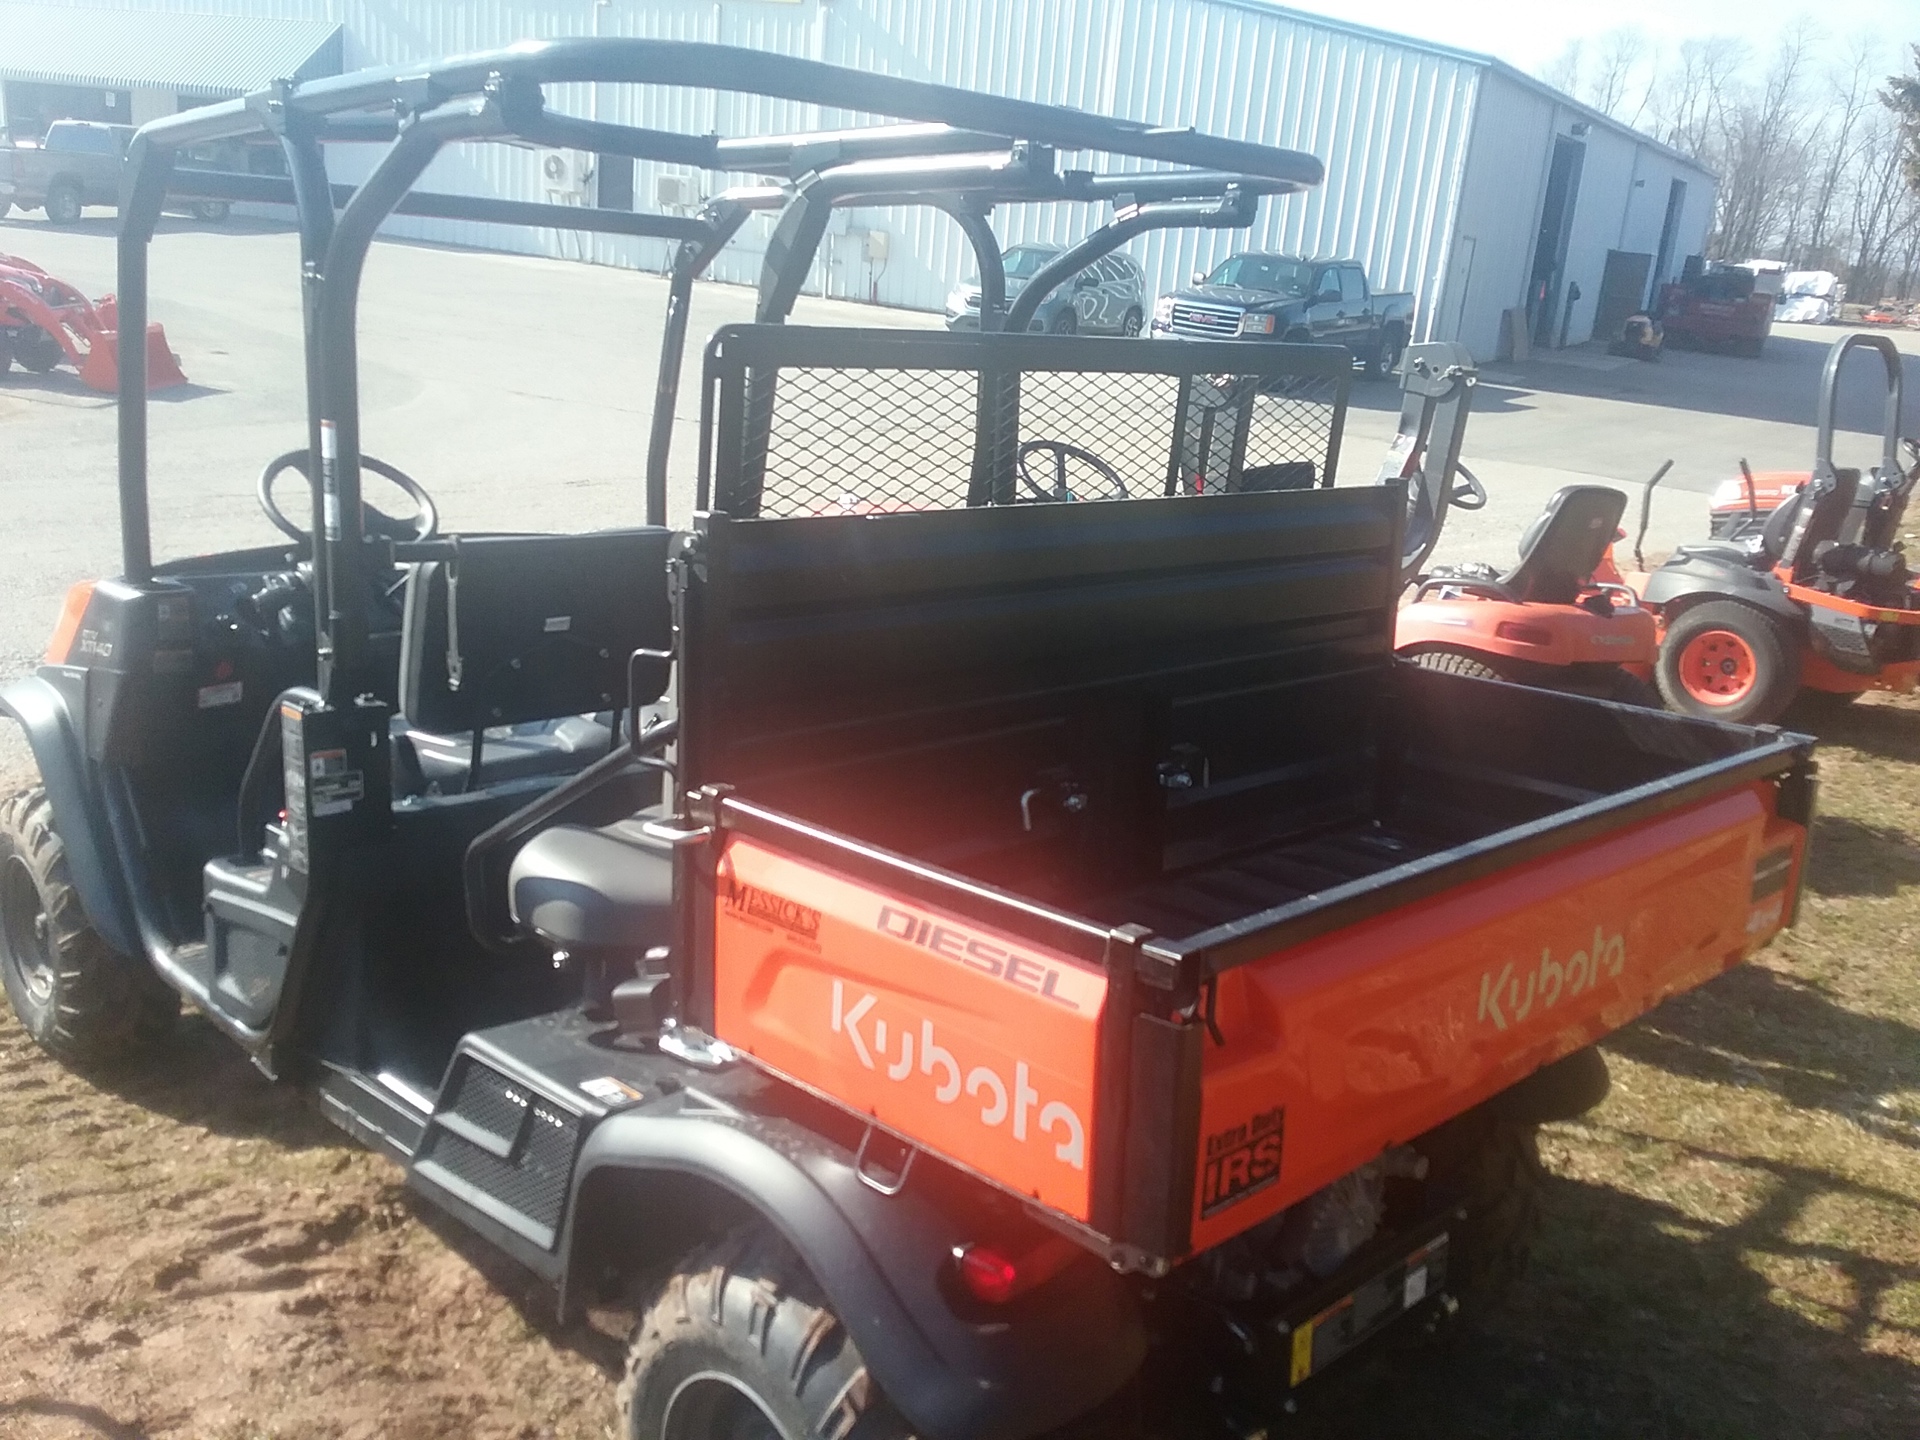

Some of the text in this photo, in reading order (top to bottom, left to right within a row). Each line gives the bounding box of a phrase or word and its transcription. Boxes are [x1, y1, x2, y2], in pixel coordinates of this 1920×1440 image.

[877, 904, 1080, 1010] DIESEL
[1478, 924, 1625, 1032] Kubota
[831, 978, 1085, 1171] Kubota
[1204, 1134, 1281, 1204] IRS
